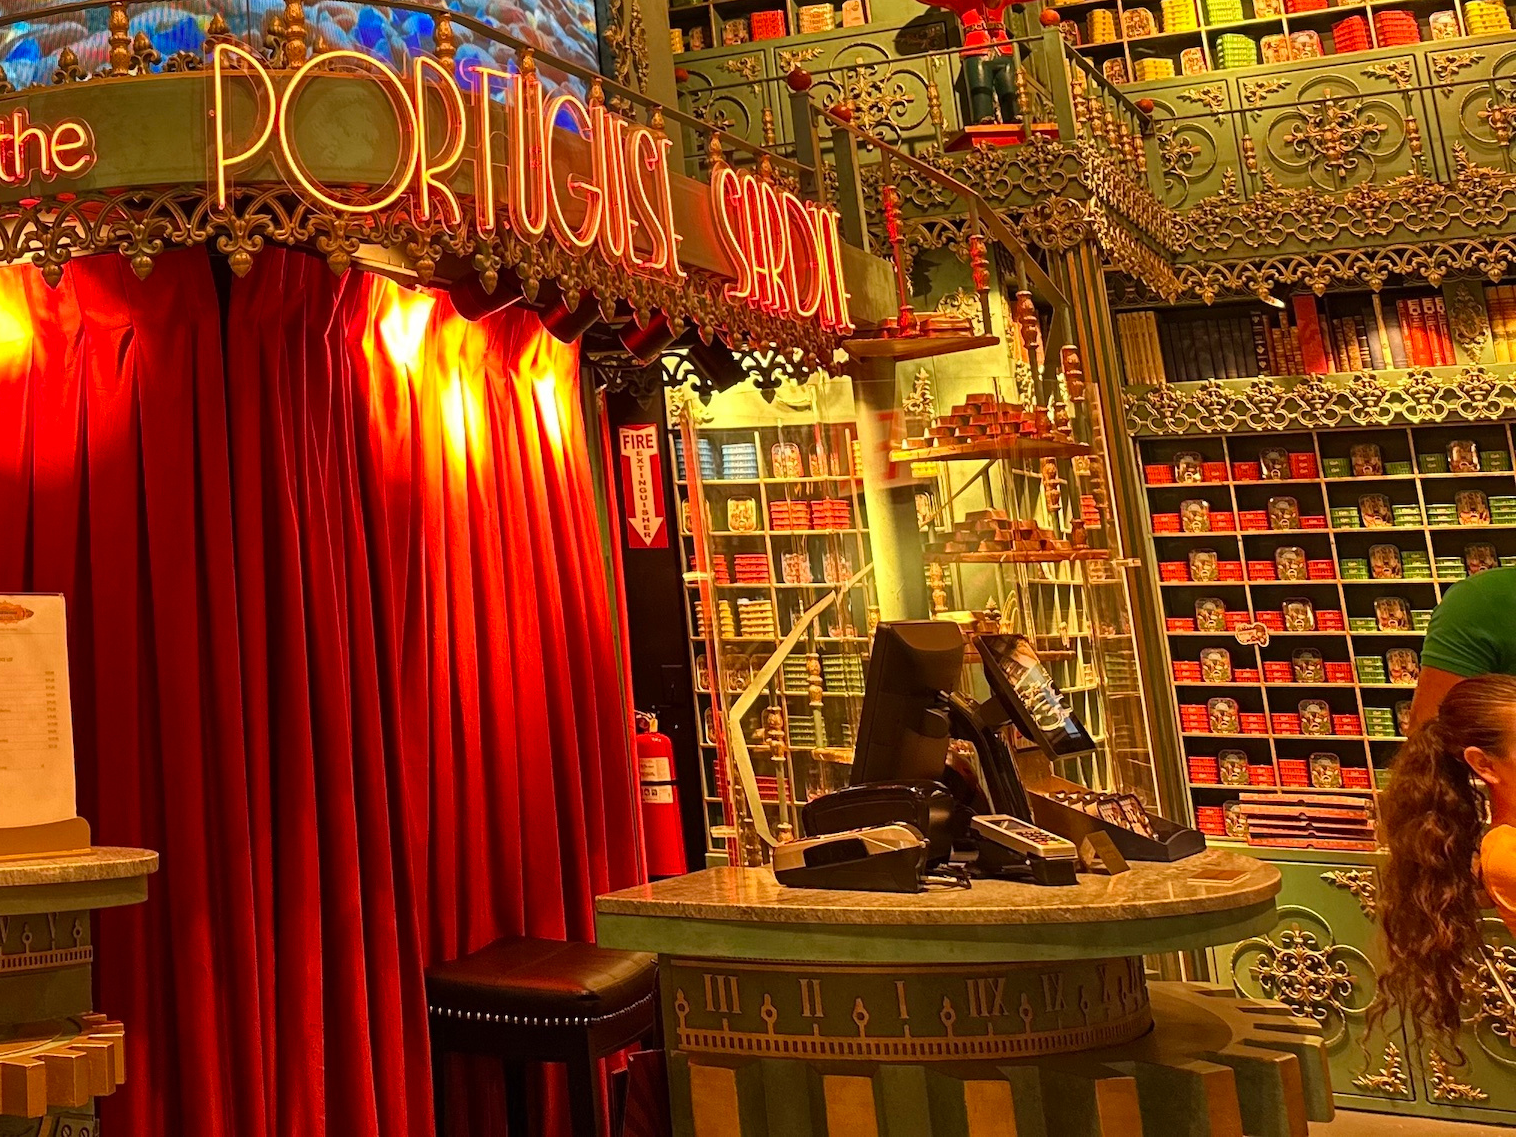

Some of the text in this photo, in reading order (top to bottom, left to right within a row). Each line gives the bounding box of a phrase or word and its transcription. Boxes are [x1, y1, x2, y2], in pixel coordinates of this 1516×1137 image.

[212, 41, 689, 279] PORTUGUESE
[714, 165, 856, 335] SARDINE
[622, 433, 654, 450] FIRE
[636, 450, 651, 539] EXTINGUISHER
[702, 973, 743, 1015] III
[798, 978, 825, 1018] II
[894, 980, 910, 1020] I
